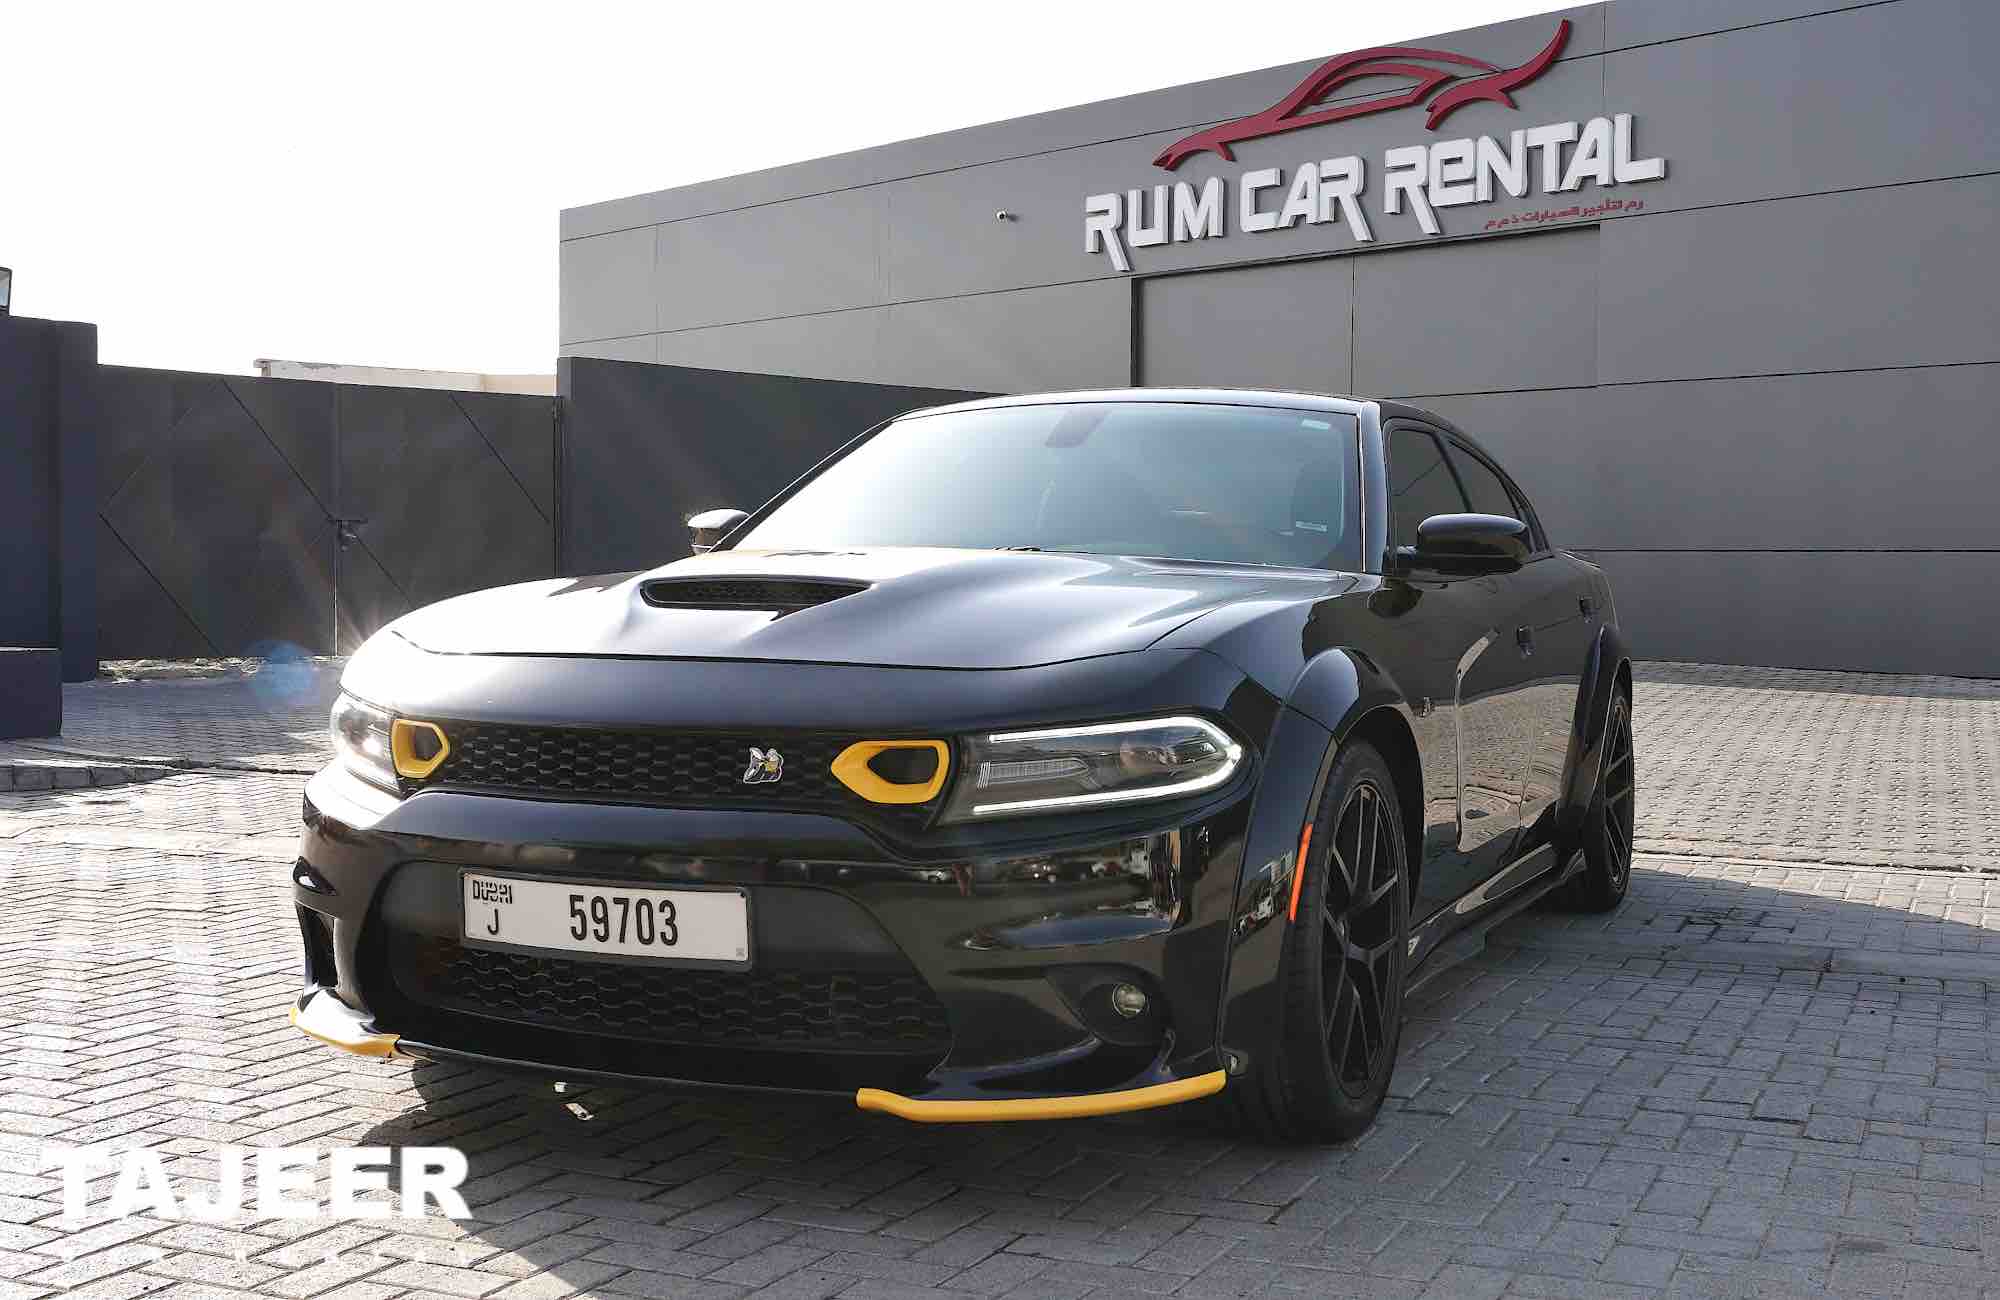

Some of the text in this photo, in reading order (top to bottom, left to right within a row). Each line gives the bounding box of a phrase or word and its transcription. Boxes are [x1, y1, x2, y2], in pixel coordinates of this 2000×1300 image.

[1085, 112, 1666, 272] RUM CAR RENTAL
[487, 894, 678, 946] J 59703
